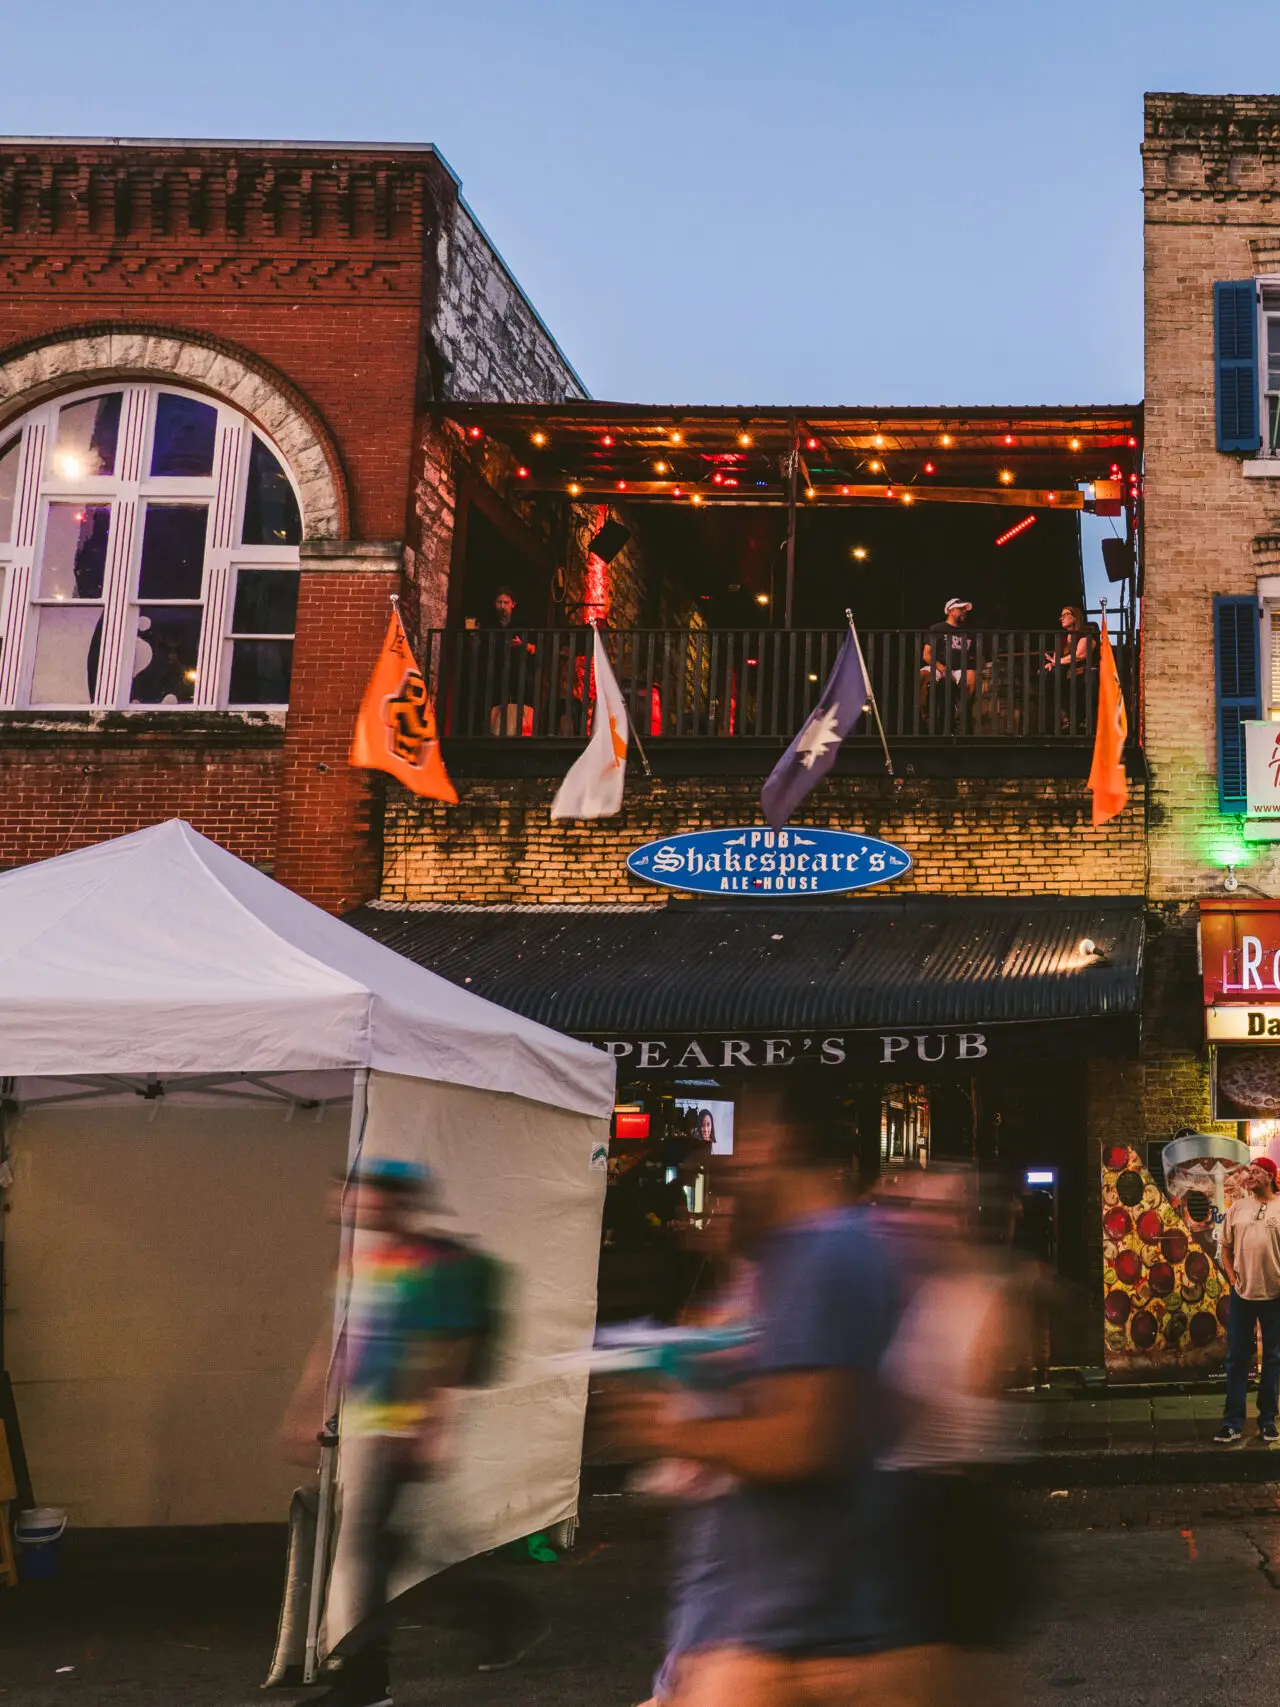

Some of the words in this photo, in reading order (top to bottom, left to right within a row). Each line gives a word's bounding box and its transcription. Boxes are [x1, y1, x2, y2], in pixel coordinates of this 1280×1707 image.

[751, 831, 789, 849] PUB
[651, 846, 886, 877] Shakespeare's
[720, 876, 749, 890] ALE
[763, 876, 819, 890] HOUSE
[880, 1032, 988, 1063] PUB
